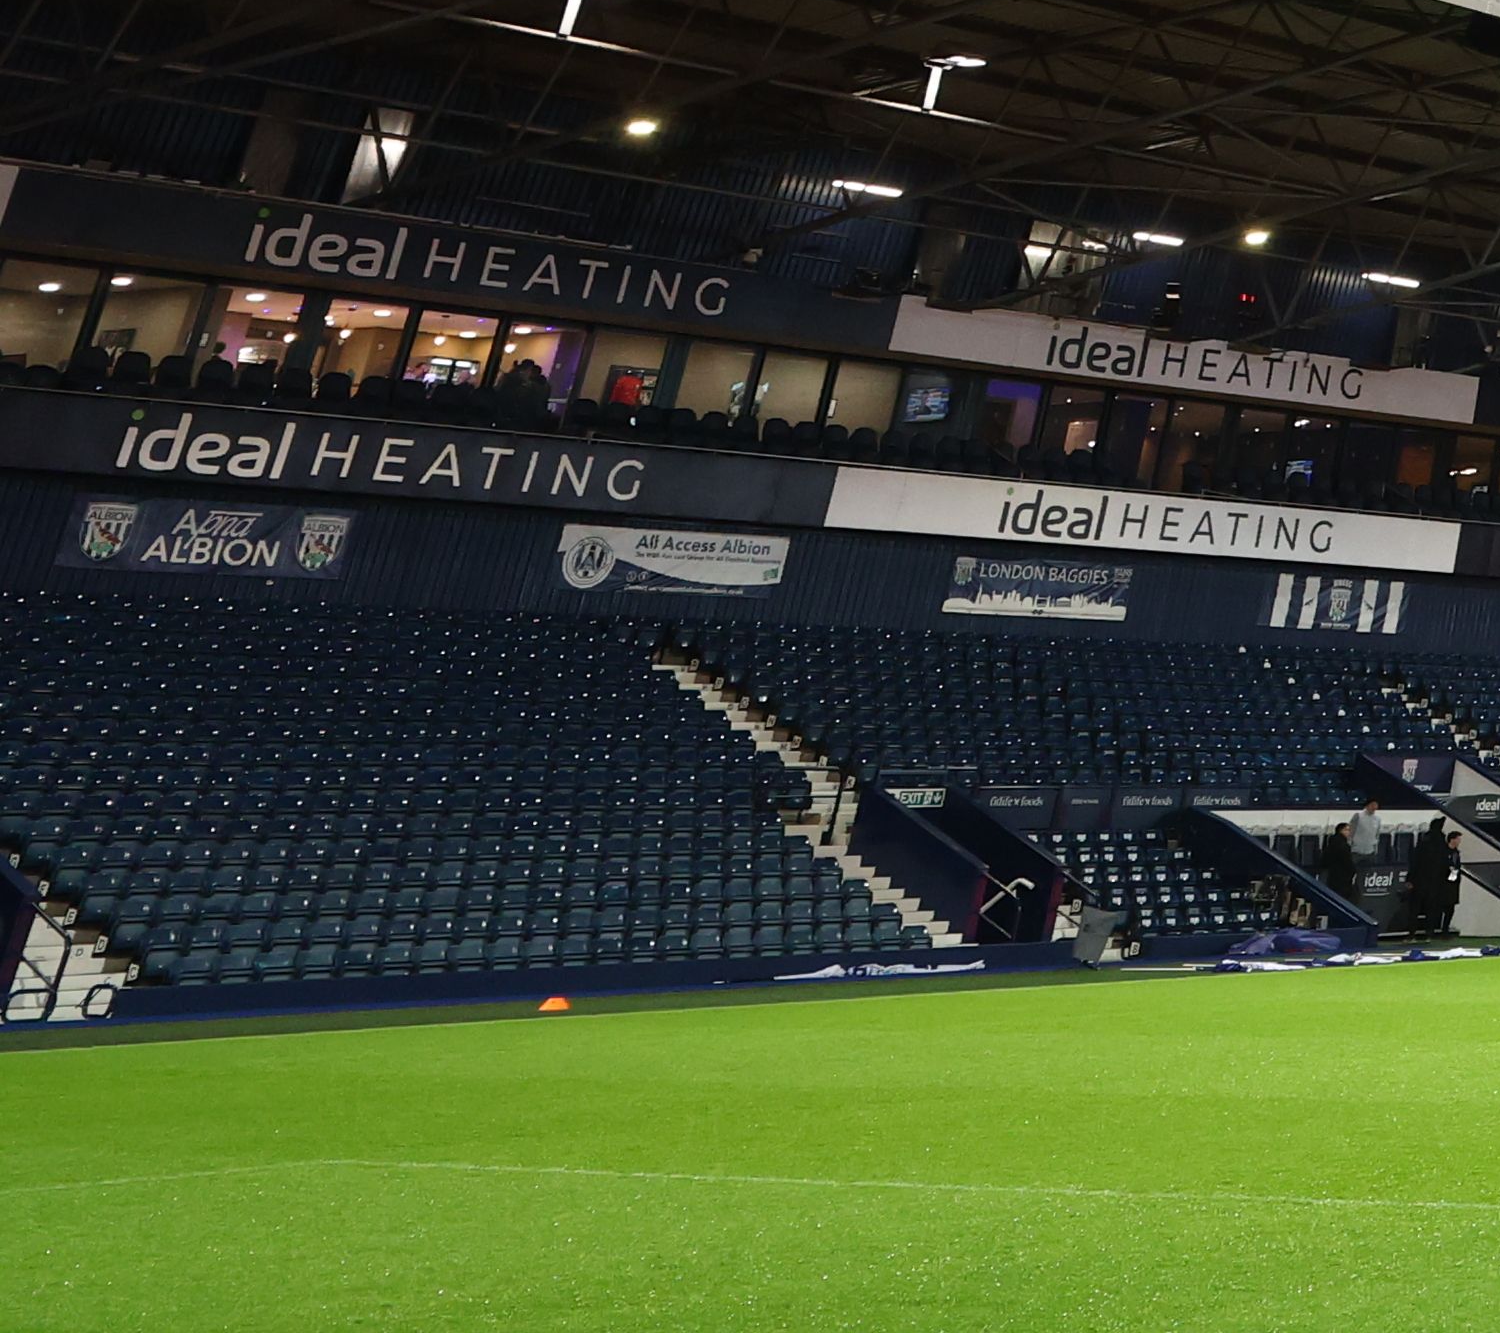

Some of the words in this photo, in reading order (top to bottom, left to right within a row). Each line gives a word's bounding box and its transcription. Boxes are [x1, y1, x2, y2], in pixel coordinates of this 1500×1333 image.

[244, 208, 408, 281] ideal
[423, 237, 730, 316] HEATING
[1046, 322, 1149, 379] ideal
[1161, 342, 1364, 400] HEATING
[115, 409, 296, 480] ideal
[309, 433, 645, 502] HEATING
[998, 487, 1108, 541] ideal
[1119, 503, 1334, 554] HEATING
[140, 535, 280, 567] ALBION
[635, 535, 658, 550] All
[663, 536, 716, 552] Access
[720, 539, 771, 555] Albion
[979, 563, 1046, 581] LONDON
[1048, 568, 1109, 585] BAGGIES
[900, 792, 924, 805] EXIT
[1475, 798, 1500, 811] ideal
[1364, 871, 1394, 887] ideal
